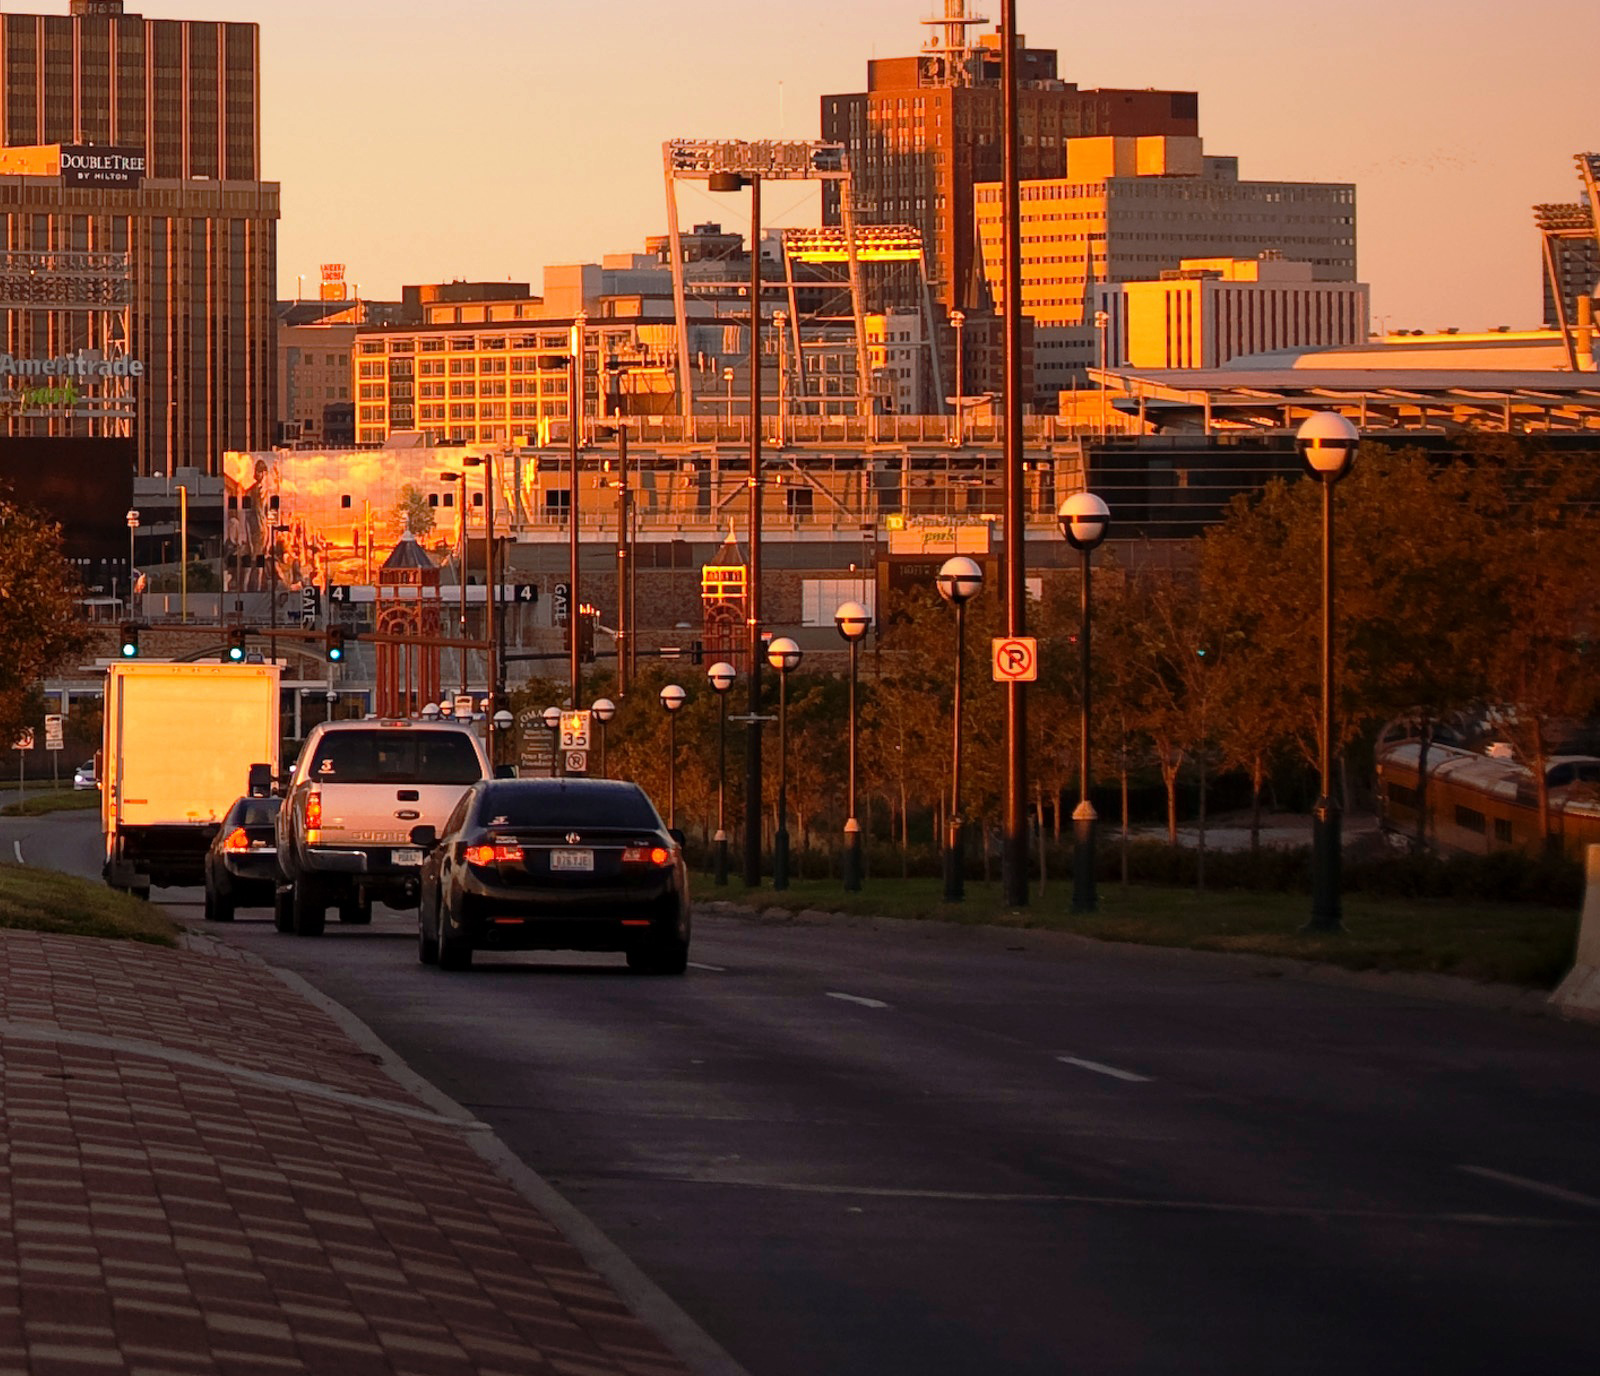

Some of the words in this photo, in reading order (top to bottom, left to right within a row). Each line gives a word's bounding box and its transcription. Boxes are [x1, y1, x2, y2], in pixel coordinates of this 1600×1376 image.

[78, 172, 90, 180] BY
[94, 172, 128, 181] HILTON
[0, 352, 143, 377] Ameritrade
[332, 586, 344, 601] 4
[520, 585, 532, 601] 4
[303, 586, 316, 623] GATE
[563, 732, 587, 746] 35
